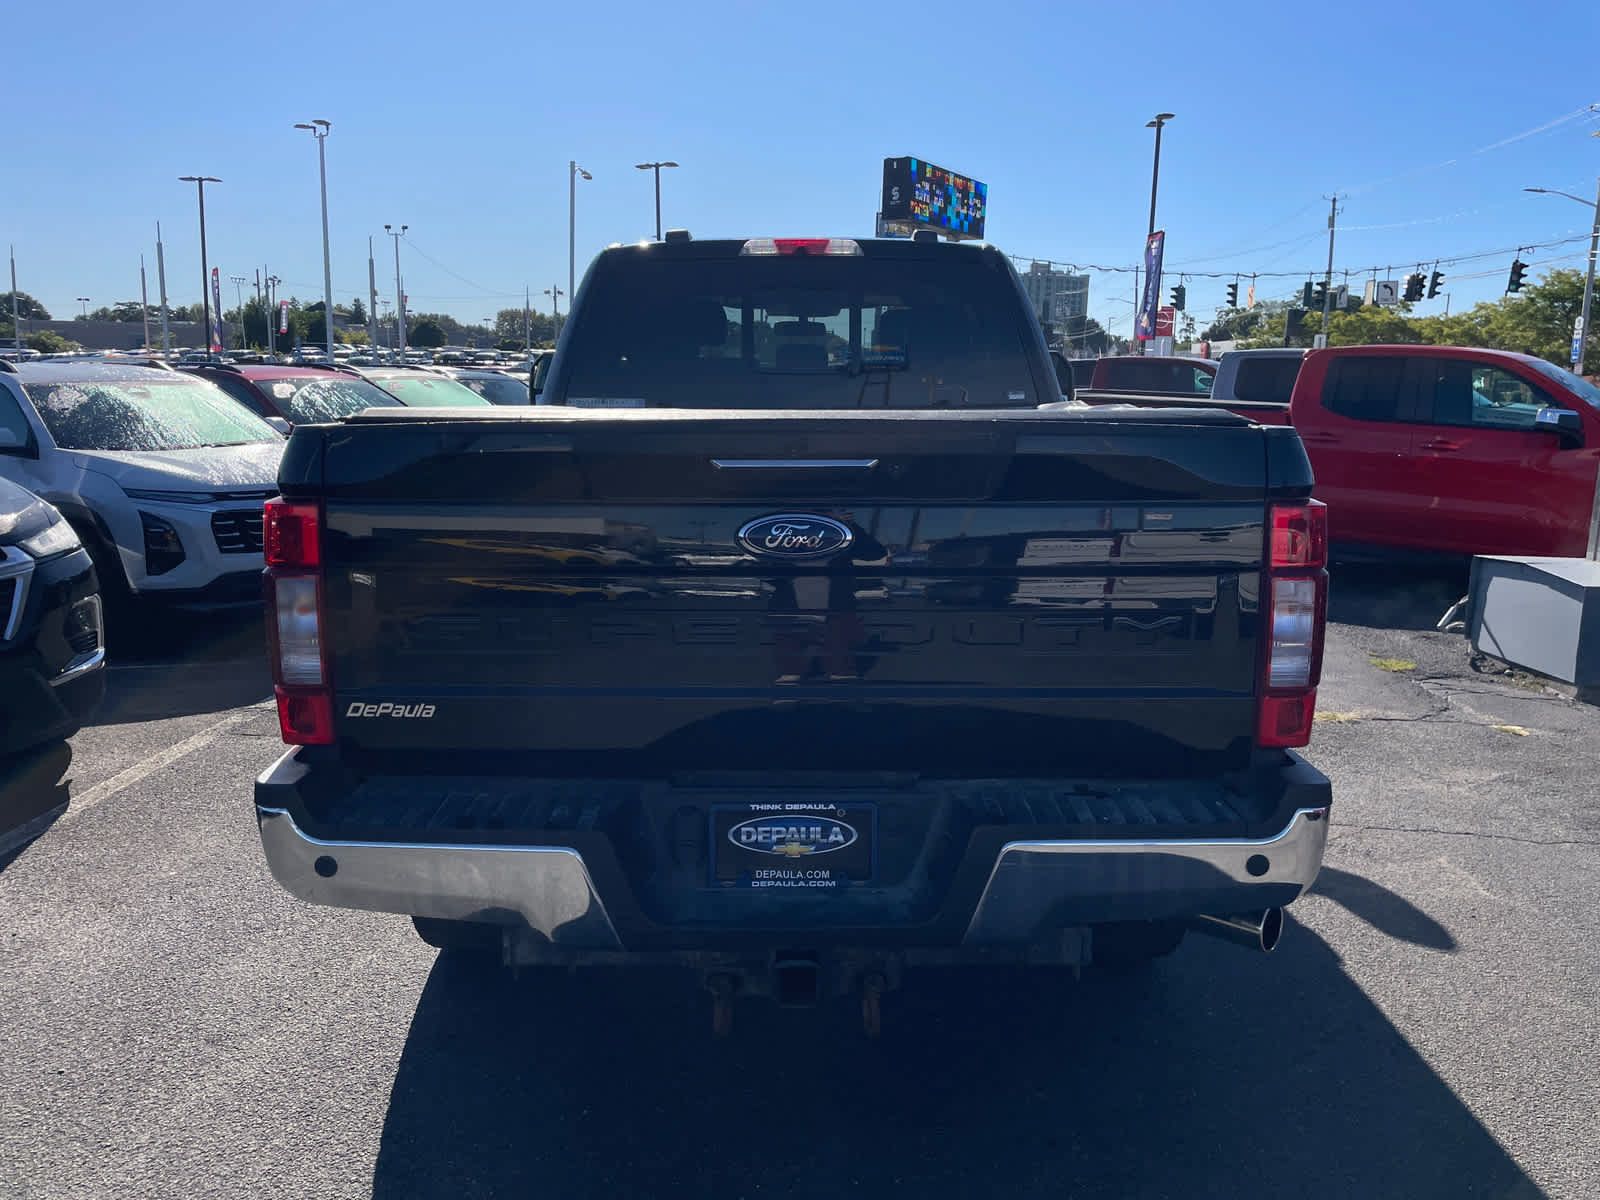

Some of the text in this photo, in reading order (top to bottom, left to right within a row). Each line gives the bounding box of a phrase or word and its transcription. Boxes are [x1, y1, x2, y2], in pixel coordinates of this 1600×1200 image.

[765, 523, 825, 548] Ford
[345, 702, 437, 718] DePaula
[740, 827, 845, 843] DEPAULA
[755, 870, 830, 879] DEPAULA.COM
